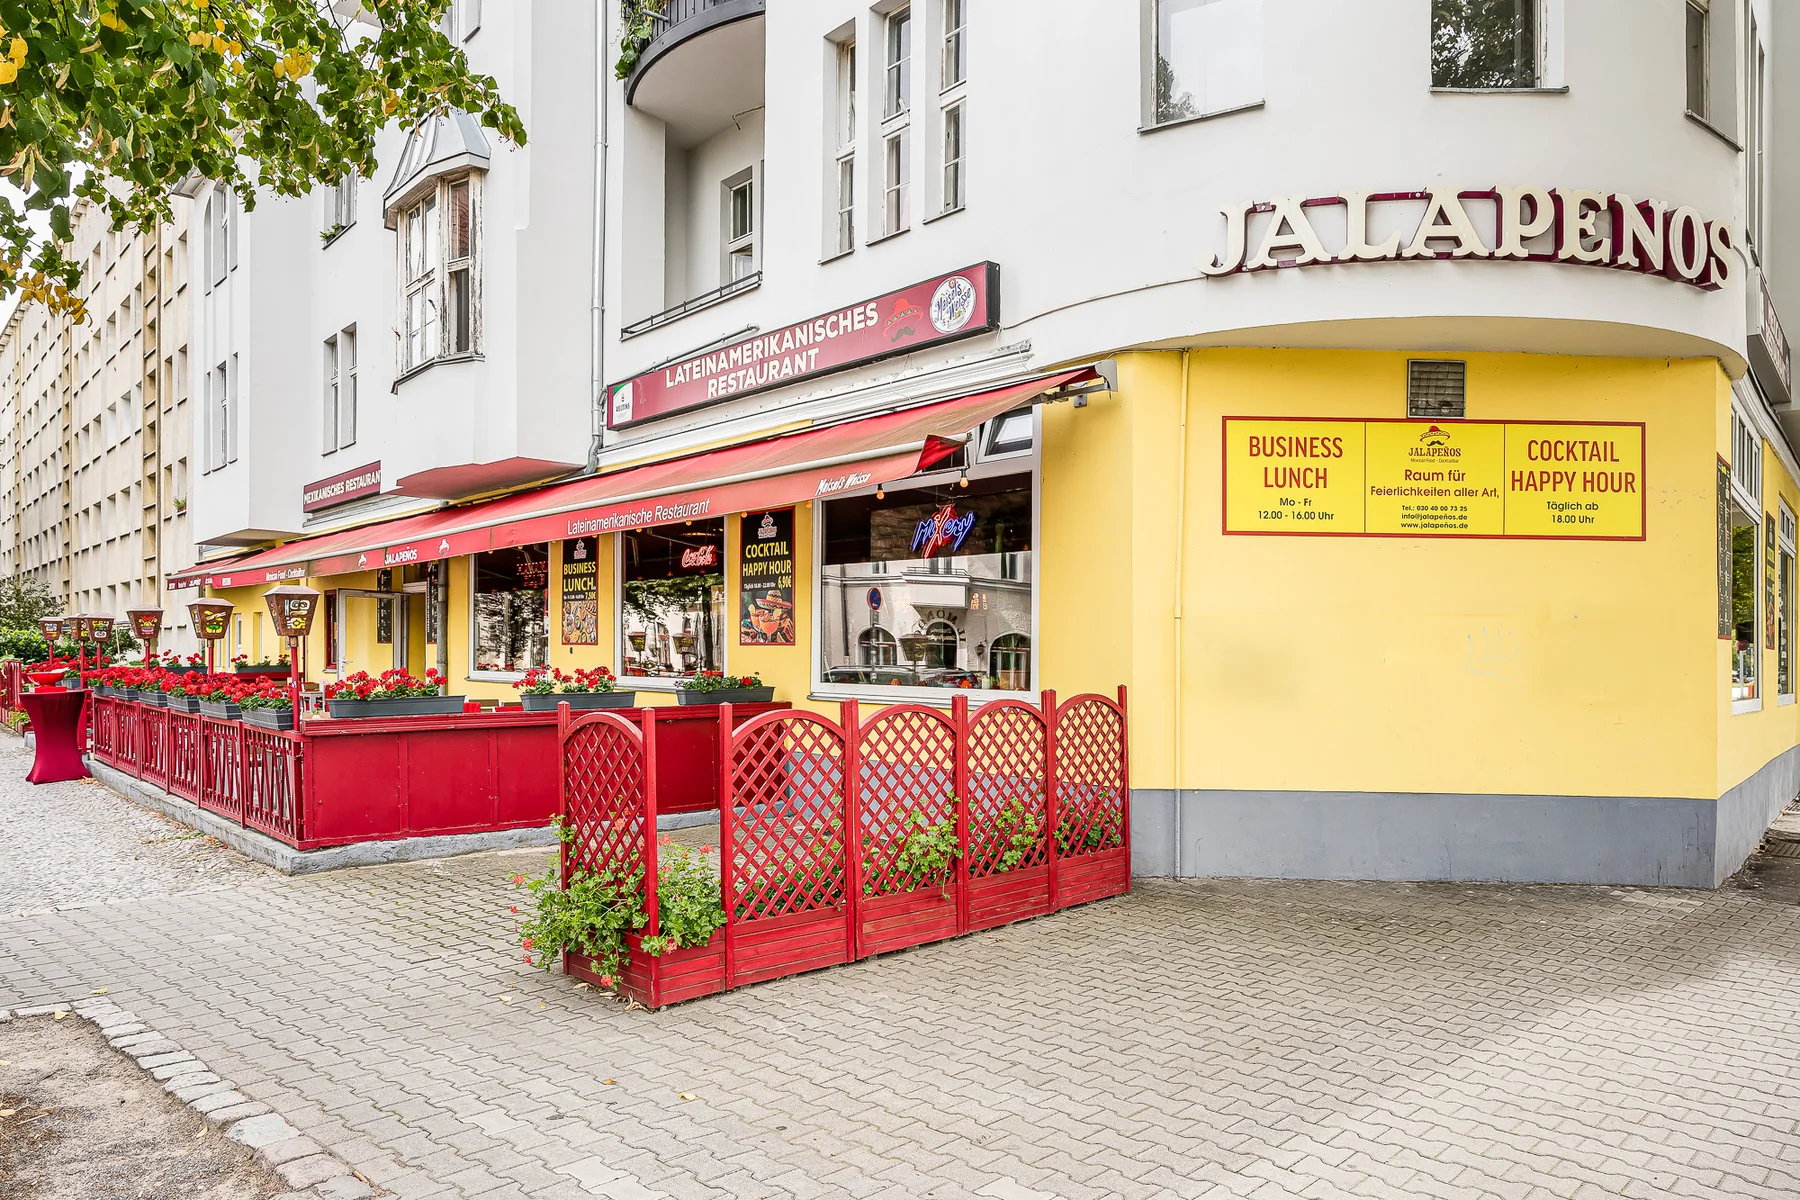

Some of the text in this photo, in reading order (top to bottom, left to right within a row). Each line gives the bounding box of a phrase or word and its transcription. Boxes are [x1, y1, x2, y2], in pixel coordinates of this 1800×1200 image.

[1199, 185, 1732, 292] JALAPENOS
[665, 302, 879, 388] LATEINAMERIKANISCHES
[707, 347, 820, 399] RESTAURANT
[1249, 435, 1343, 458] BUSINESS
[1408, 446, 1461, 457] JALAPEÑOS
[1527, 439, 1620, 462] COCKTAIL
[1263, 466, 1328, 489] LUNCH
[1404, 469, 1466, 482] Raum für
[1511, 470, 1636, 493] HAPPY HOUR
[1370, 486, 1500, 499] Feierlichkeiten aller Art,
[1279, 497, 1295, 507] Mo
[1303, 497, 1312, 507] Fr
[1547, 501, 1599, 512] Täglich ab
[567, 497, 711, 535] Lateinamerikanische Restaurant
[1258, 510, 1282, 520] 12.00
[1291, 511, 1315, 520] 16.00
[1317, 511, 1335, 520] Uhr
[1401, 513, 1468, 521] info@jalapeños.de
[1552, 515, 1595, 524] 18.00 Uhr
[384, 546, 418, 565] JALAPEÑOS
[745, 541, 789, 558] COCKTAIL
[563, 561, 596, 575] BUSINESS
[742, 559, 792, 577] HAPPY HOUR
[563, 577, 594, 592] LUNCH
